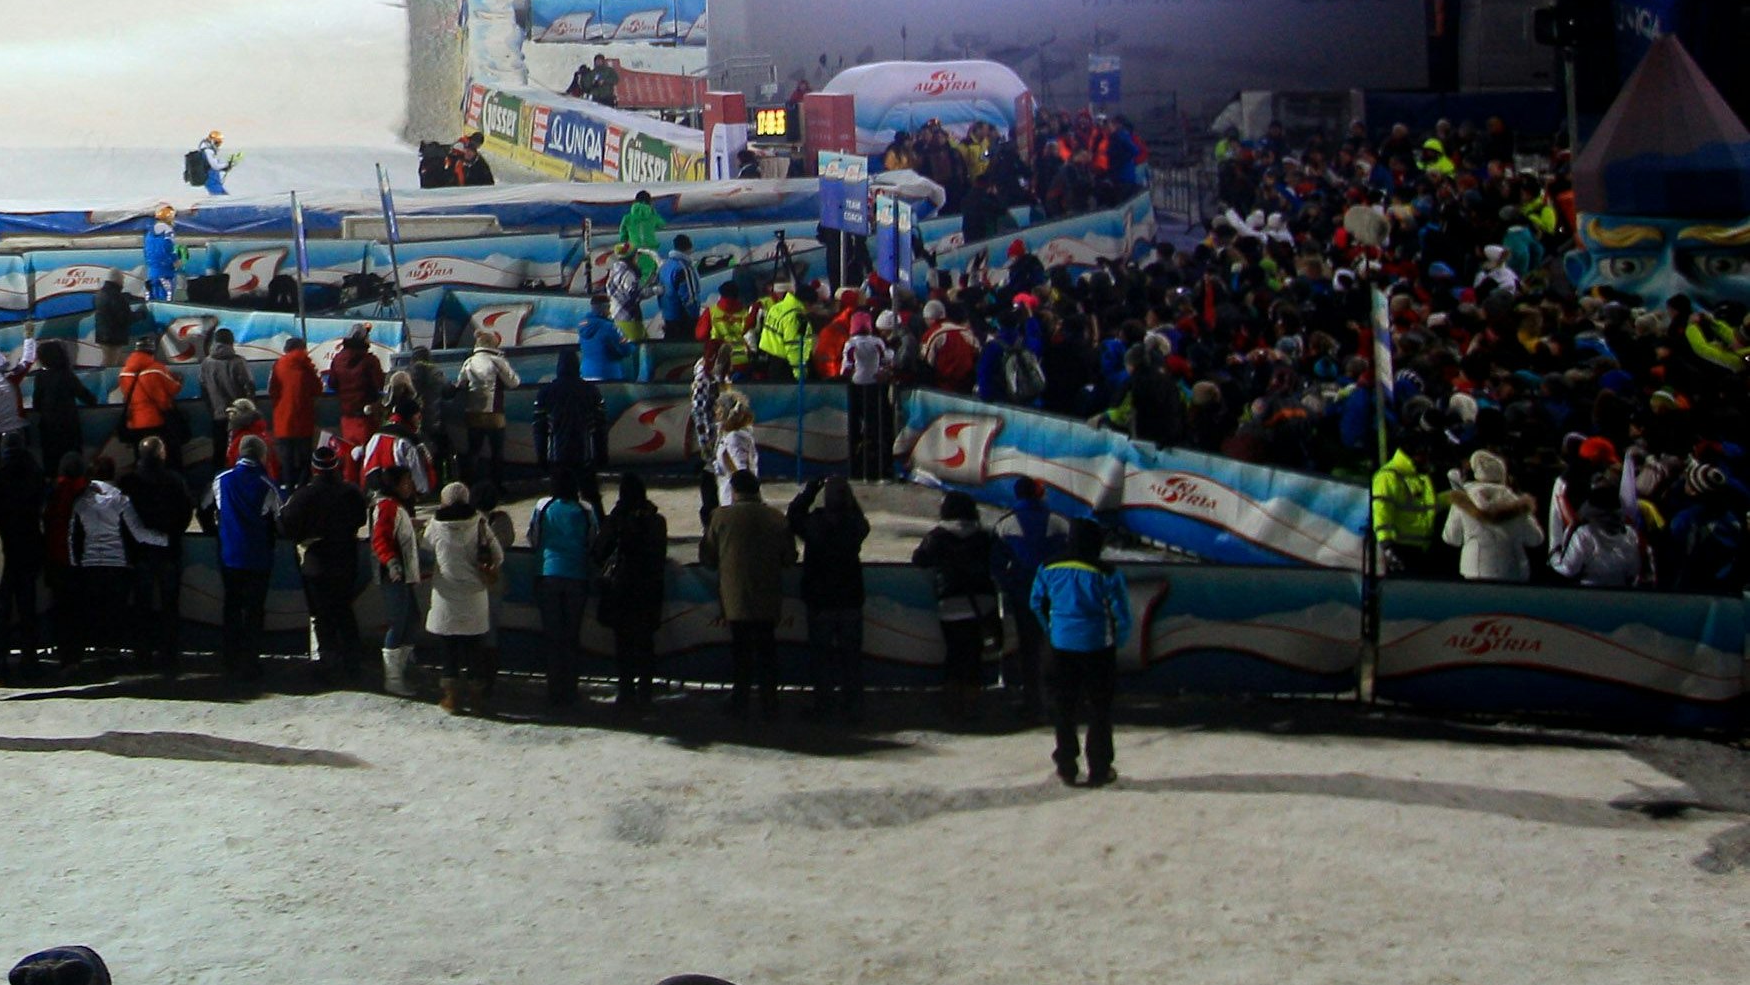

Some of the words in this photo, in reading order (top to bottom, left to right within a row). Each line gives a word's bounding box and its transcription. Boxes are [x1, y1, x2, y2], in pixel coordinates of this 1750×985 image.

[914, 80, 976, 96] AUSTRIA
[1100, 80, 1109, 95] 5
[566, 122, 603, 164] UNIQA
[53, 276, 101, 287] AUSTRIA
[405, 268, 453, 280] AUSTRIA
[1149, 482, 1218, 510] AUSTRIA
[1443, 635, 1542, 654] AUSTRIA
